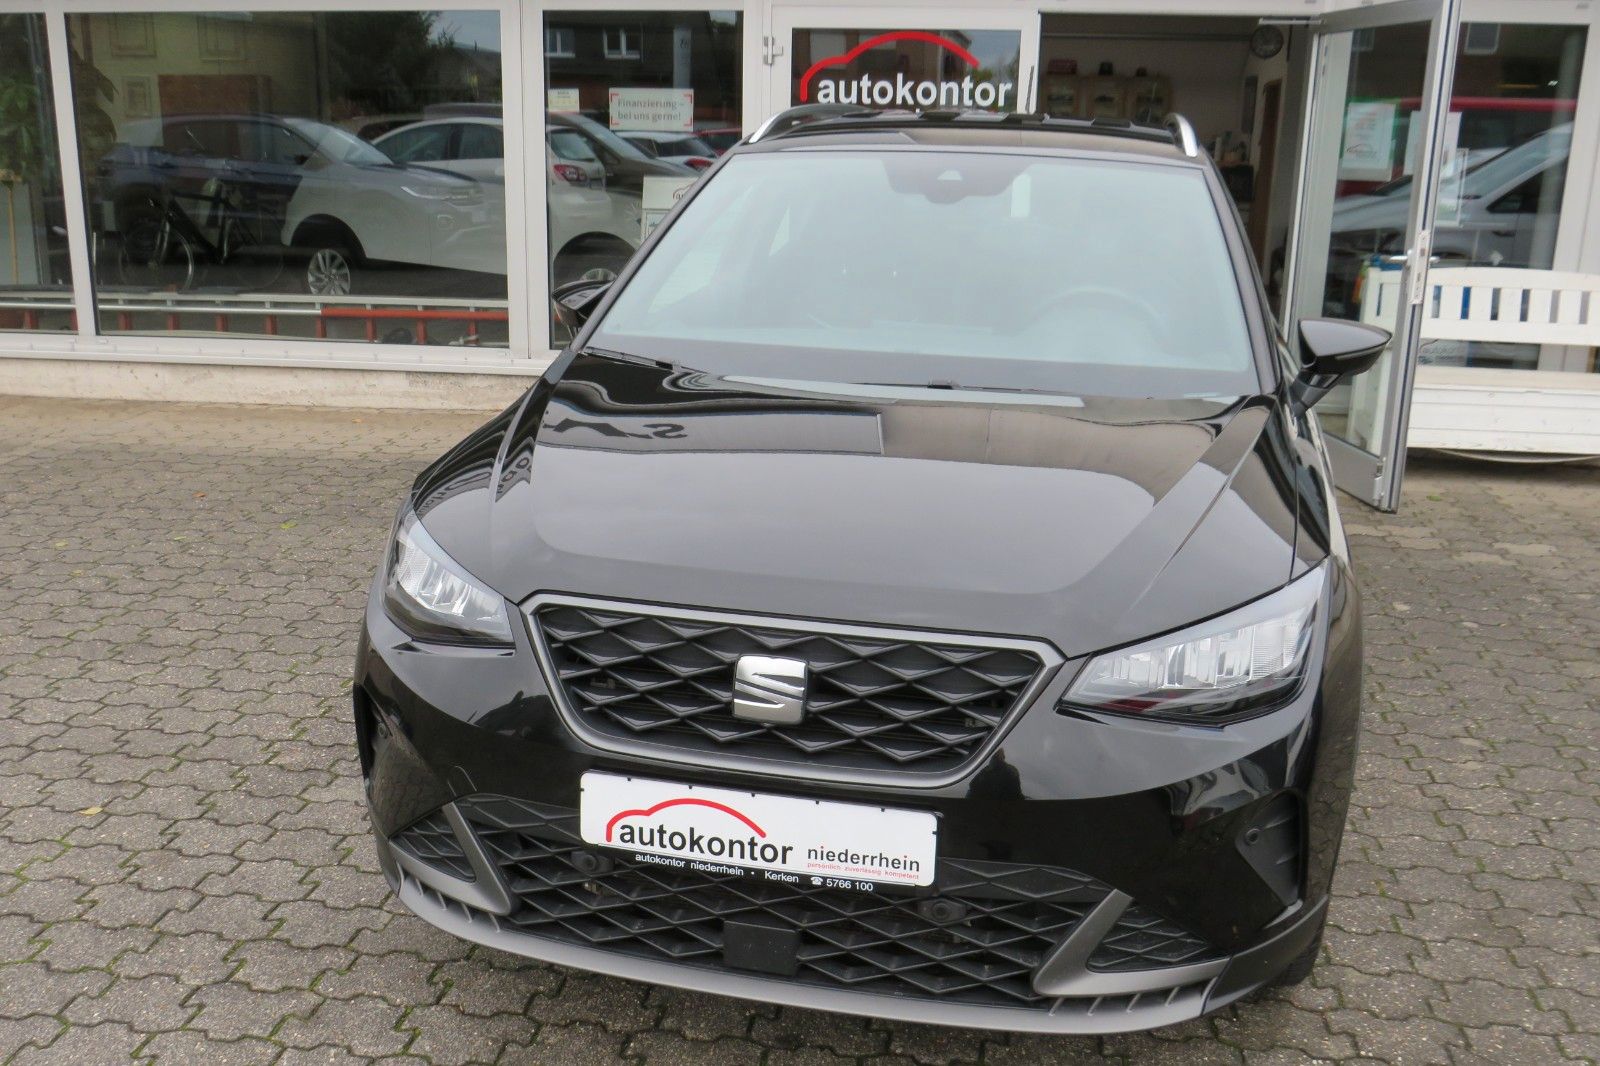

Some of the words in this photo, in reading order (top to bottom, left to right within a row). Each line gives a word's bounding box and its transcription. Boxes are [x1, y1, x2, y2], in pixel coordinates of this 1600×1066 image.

[817, 73, 1013, 107] autokontor
[619, 823, 793, 865] autokontor
[807, 845, 920, 872] niederrhein
[635, 854, 686, 868] autokontor
[690, 860, 744, 876] niederrhein
[764, 871, 800, 883] Kerken
[826, 880, 852, 889] 5766
[855, 881, 874, 891] 100
